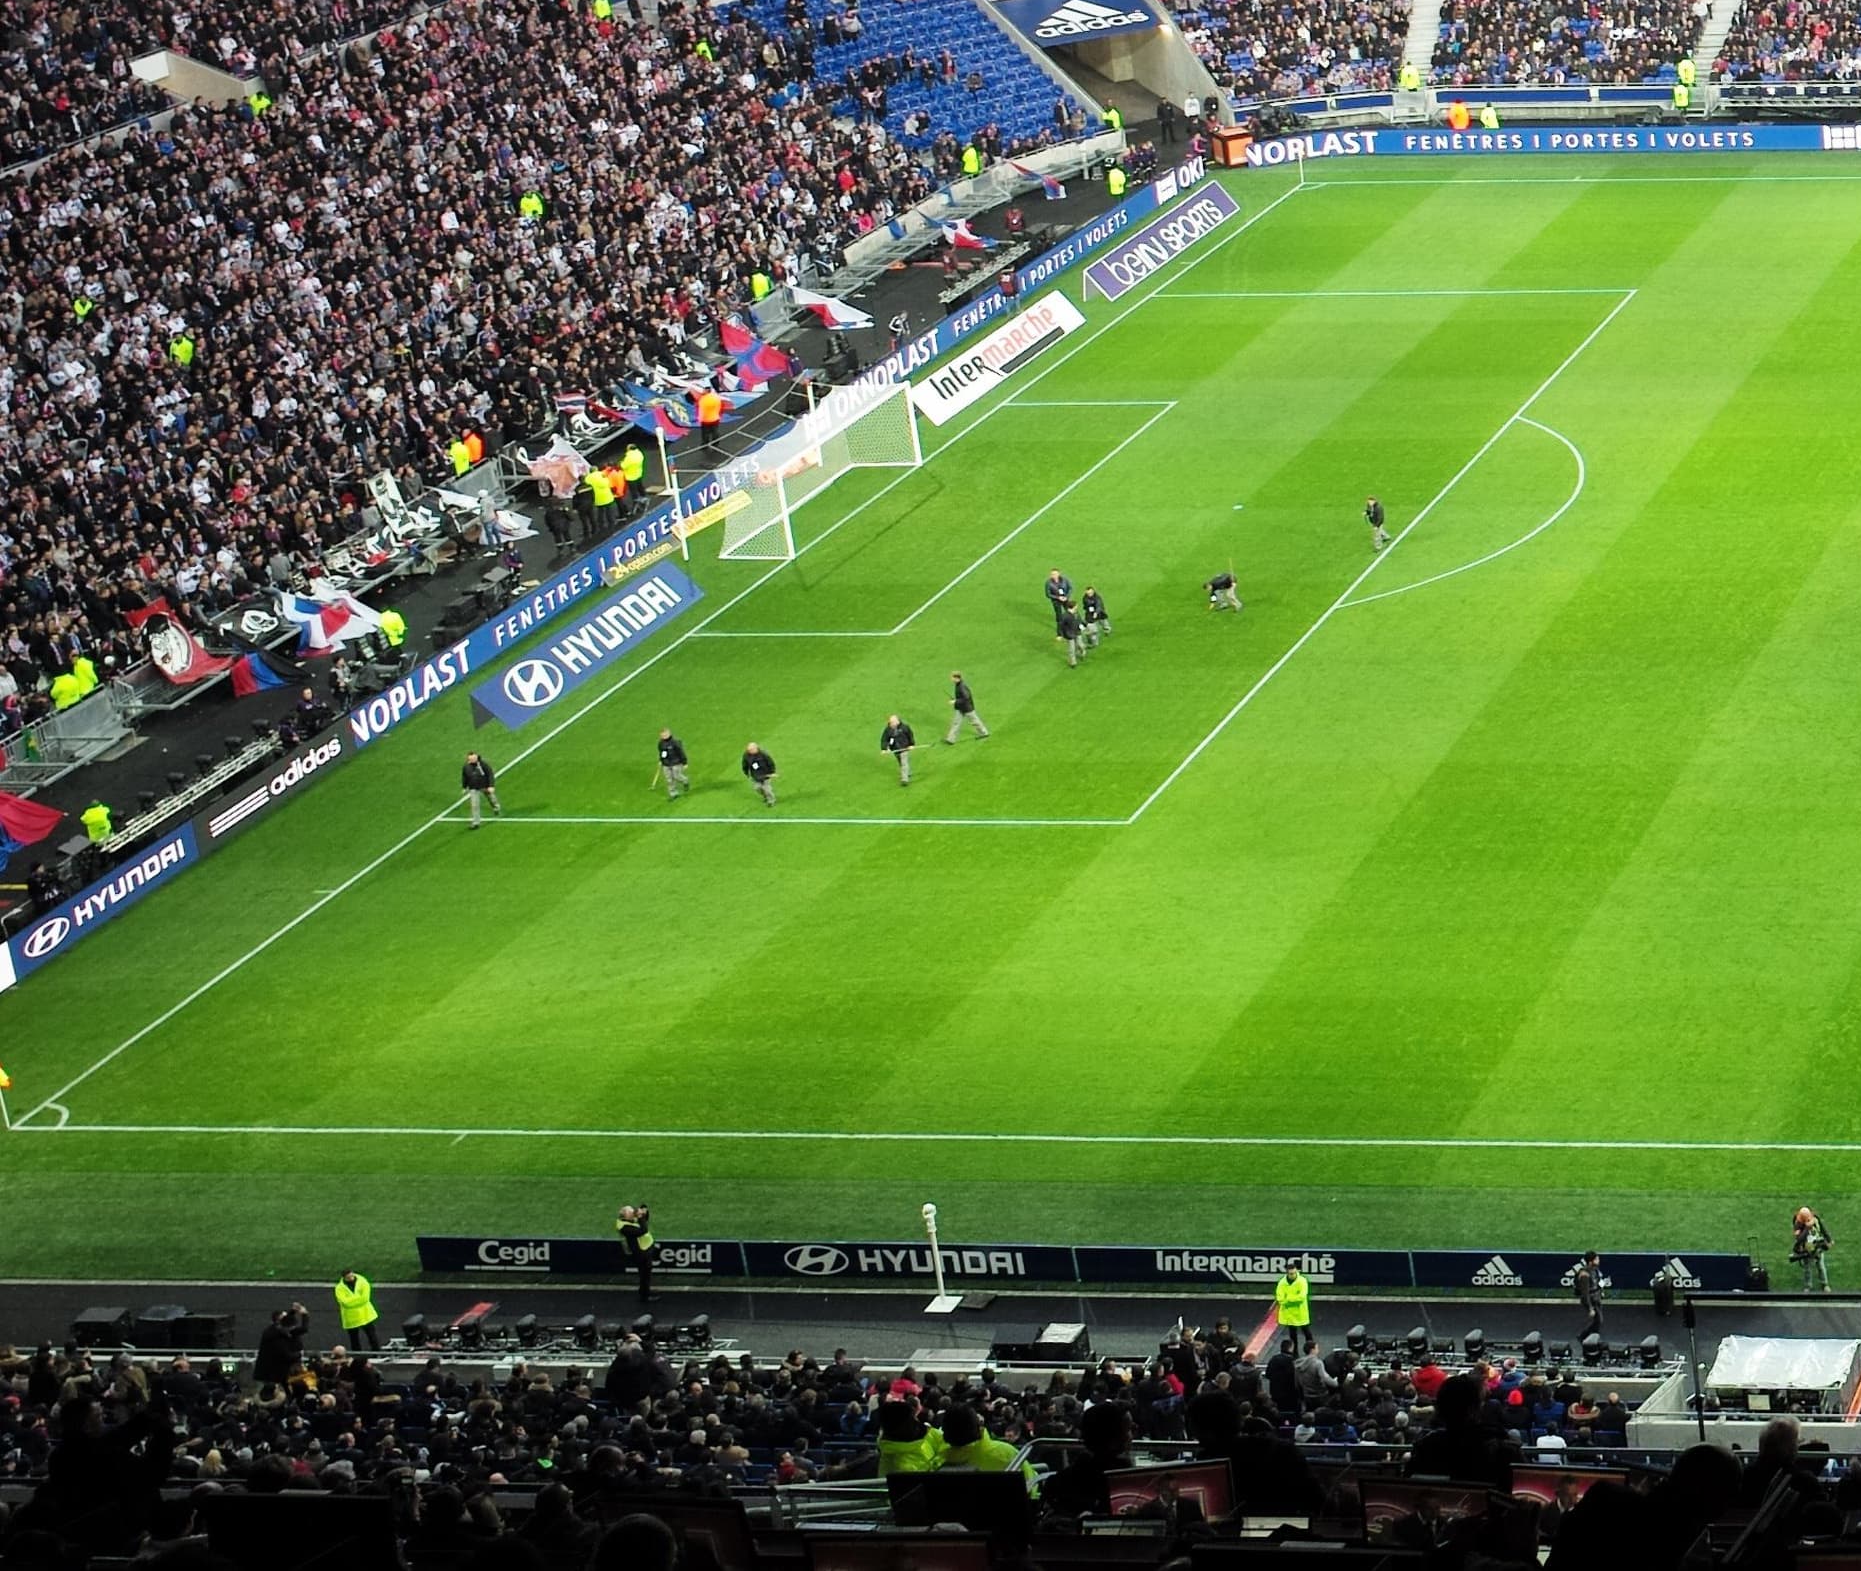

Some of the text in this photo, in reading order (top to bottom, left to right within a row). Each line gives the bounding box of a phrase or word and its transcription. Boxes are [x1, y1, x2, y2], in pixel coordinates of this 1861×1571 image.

[1035, 11, 1149, 38] adidas
[1406, 132, 1754, 150] FENÊTRES PORTES VOLETS
[1030, 245, 1074, 283] PORTES
[1087, 211, 1128, 246] VOLETS
[1163, 198, 1223, 252] SPORTS
[495, 567, 594, 646] FENÊTRES
[613, 507, 684, 563] PORTES
[699, 456, 760, 508] VOLETS
[552, 578, 682, 675] HYUNDAI
[270, 737, 341, 795] adidas
[73, 838, 185, 927] HYUNDAI
[478, 1241, 550, 1265] Cegid
[858, 1250, 1027, 1275] HYUNDAI
[1472, 1274, 1523, 1287] adidas
